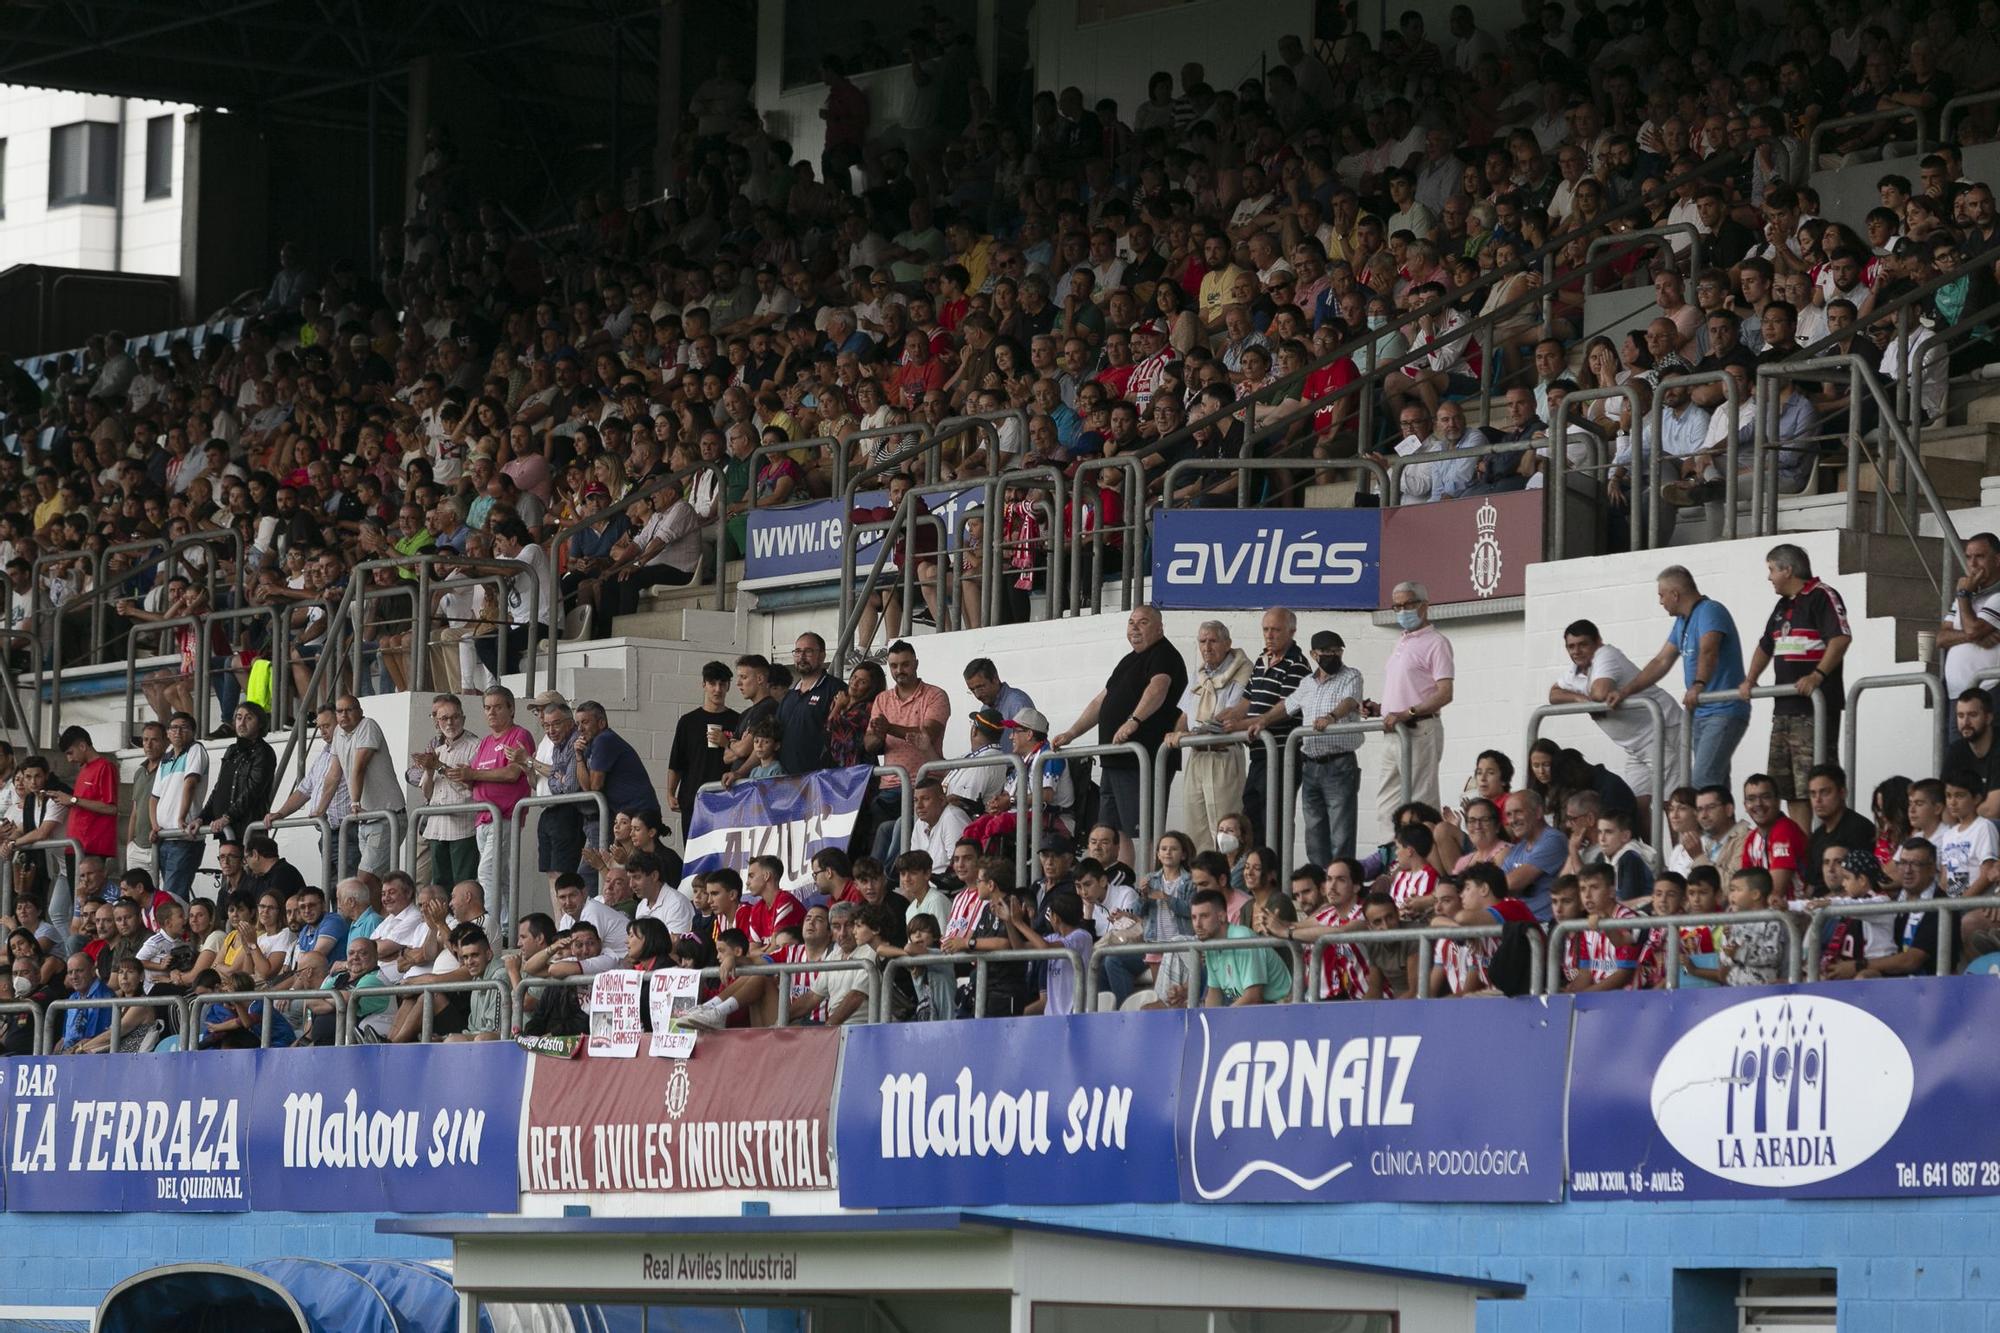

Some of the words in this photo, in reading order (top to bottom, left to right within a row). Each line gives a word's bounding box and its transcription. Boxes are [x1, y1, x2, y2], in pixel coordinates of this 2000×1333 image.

[1166, 529, 1368, 584] avilés
[596, 992, 604, 1005] ME
[607, 993, 635, 1005] ENCANTAS
[614, 1006, 623, 1018] ME
[628, 1006, 639, 1018] DAS
[614, 1019, 623, 1030] TU
[538, 1036, 564, 1052] Castro
[16, 1064, 57, 1097] BAR
[1210, 1035, 1422, 1140] ARNAIZ
[880, 1066, 1051, 1158] Mahou
[1062, 1084, 1133, 1155] SIN
[11, 1103, 56, 1174] LA
[68, 1097, 240, 1174] TERRAZA
[283, 1088, 419, 1169] Mahou
[428, 1108, 486, 1168] SIN
[530, 1126, 589, 1190] REAL
[594, 1123, 673, 1190] AVILES
[679, 1119, 830, 1189] INDUSTRIAL
[1371, 1144, 1424, 1176] CLÍNICA
[1428, 1143, 1530, 1176] PODOLÓGICA
[1718, 1139, 1747, 1168] LA
[1753, 1136, 1837, 1168] ABADIA
[158, 1177, 178, 1199] DEL
[180, 1176, 243, 1204] QUIRINAL
[1572, 1171, 1599, 1192] JUAN
[1630, 1172, 1643, 1192] 18
[1651, 1167, 1685, 1192] AVILÉS
[1895, 1162, 1920, 1187] Tel.
[1923, 1162, 1948, 1187] 641
[1952, 1161, 1977, 1187] 687
[1981, 1161, 2000, 1186] 28
[643, 1253, 674, 1280] Real
[678, 1252, 722, 1280] Avilés
[725, 1252, 797, 1280] Industrial
